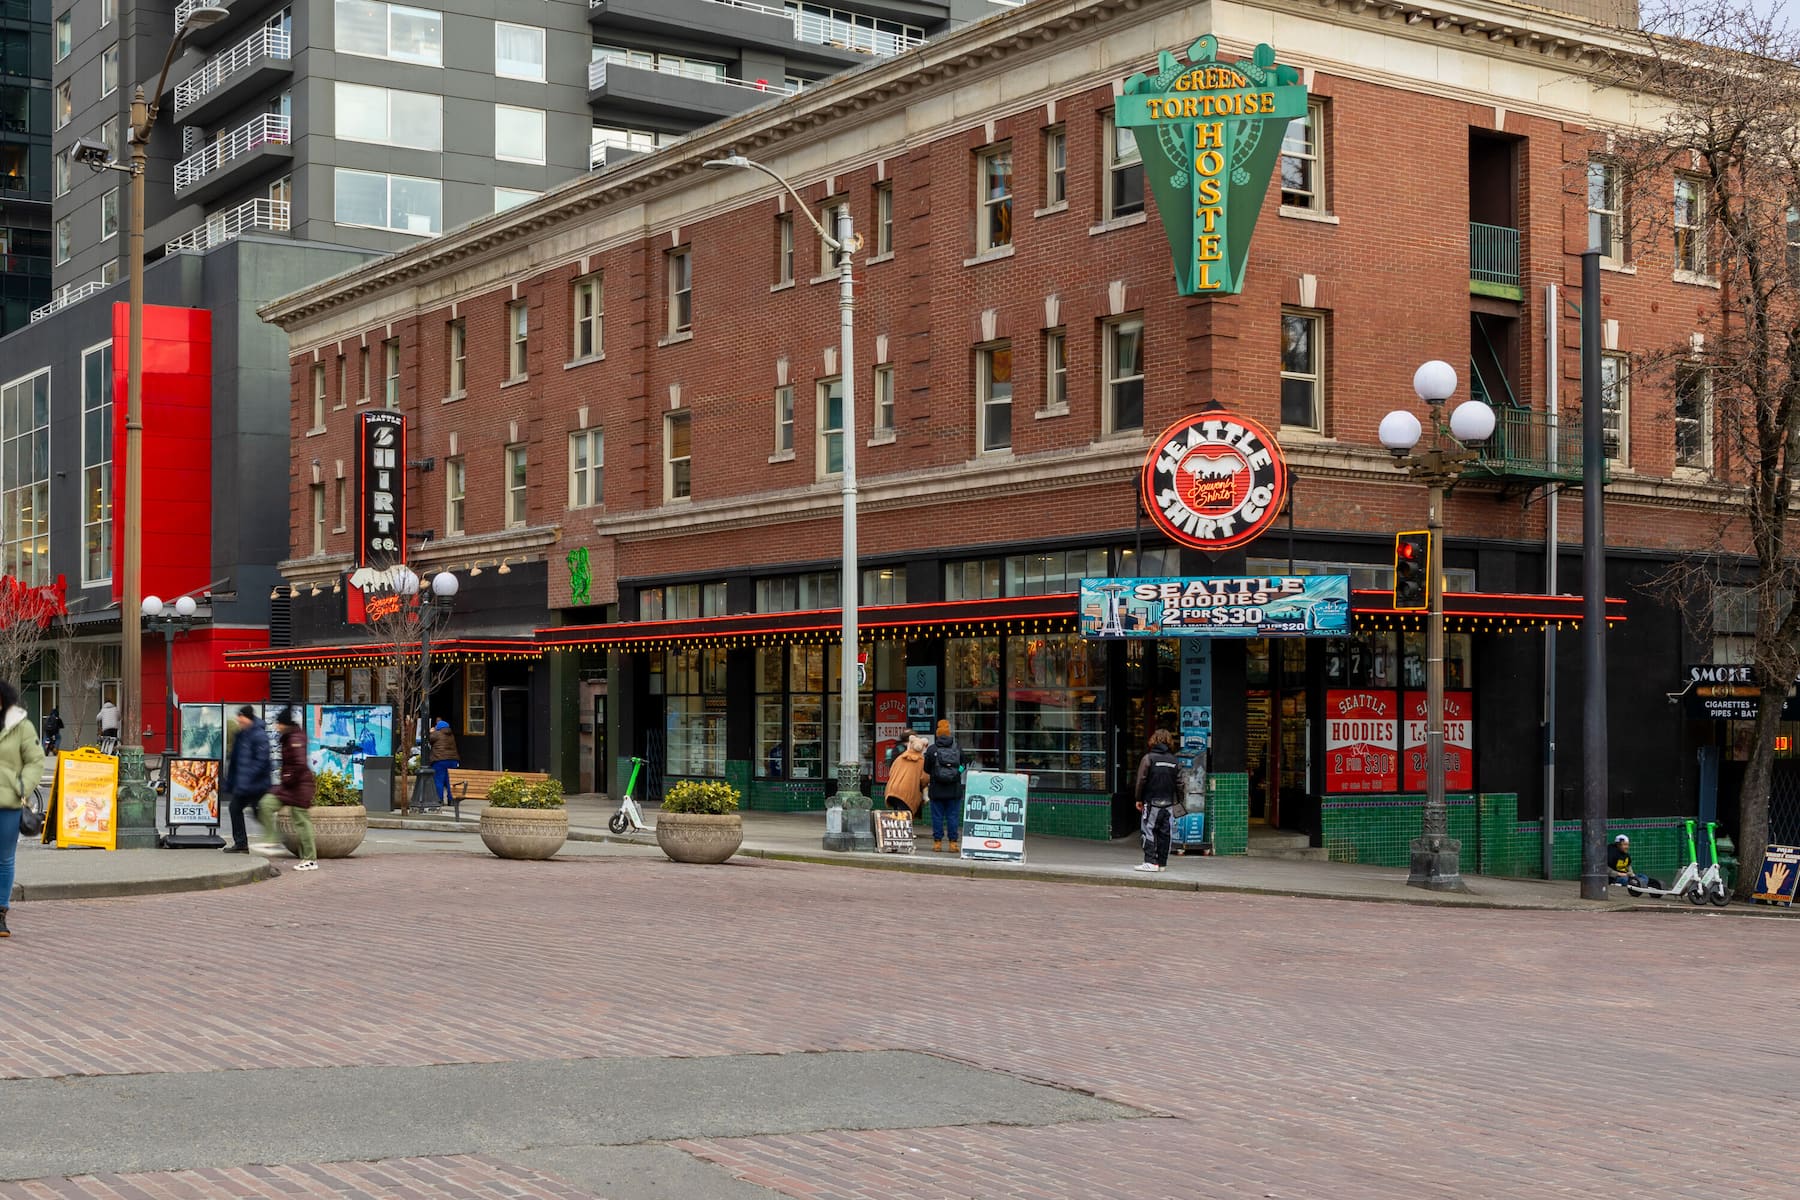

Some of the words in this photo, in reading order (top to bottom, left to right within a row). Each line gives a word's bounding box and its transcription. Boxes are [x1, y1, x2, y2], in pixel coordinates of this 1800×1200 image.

[1174, 68, 1247, 90] GREEN
[1147, 92, 1276, 120] TORTOISE
[1195, 122, 1224, 290] HOSTEL
[1156, 420, 1272, 474] SEATTLE
[373, 426, 396, 534] SHIRT
[1188, 479, 1237, 498] Souvenir
[1196, 489, 1237, 507] Shirts
[1156, 488, 1236, 540] SHIRT
[1134, 578, 1305, 600] SEATTLE
[1164, 592, 1268, 608] HOODIES
[1162, 608, 1181, 624] 2
[1183, 608, 1210, 618] FOR
[1211, 606, 1262, 625] $30
[1691, 667, 1751, 682] SMOKE
[880, 700, 906, 713] SEATTLE
[1338, 694, 1386, 716] SEATTLE
[1332, 722, 1393, 741] HOODIES
[1335, 754, 1343, 774] 2
[1364, 754, 1388, 774] $30
